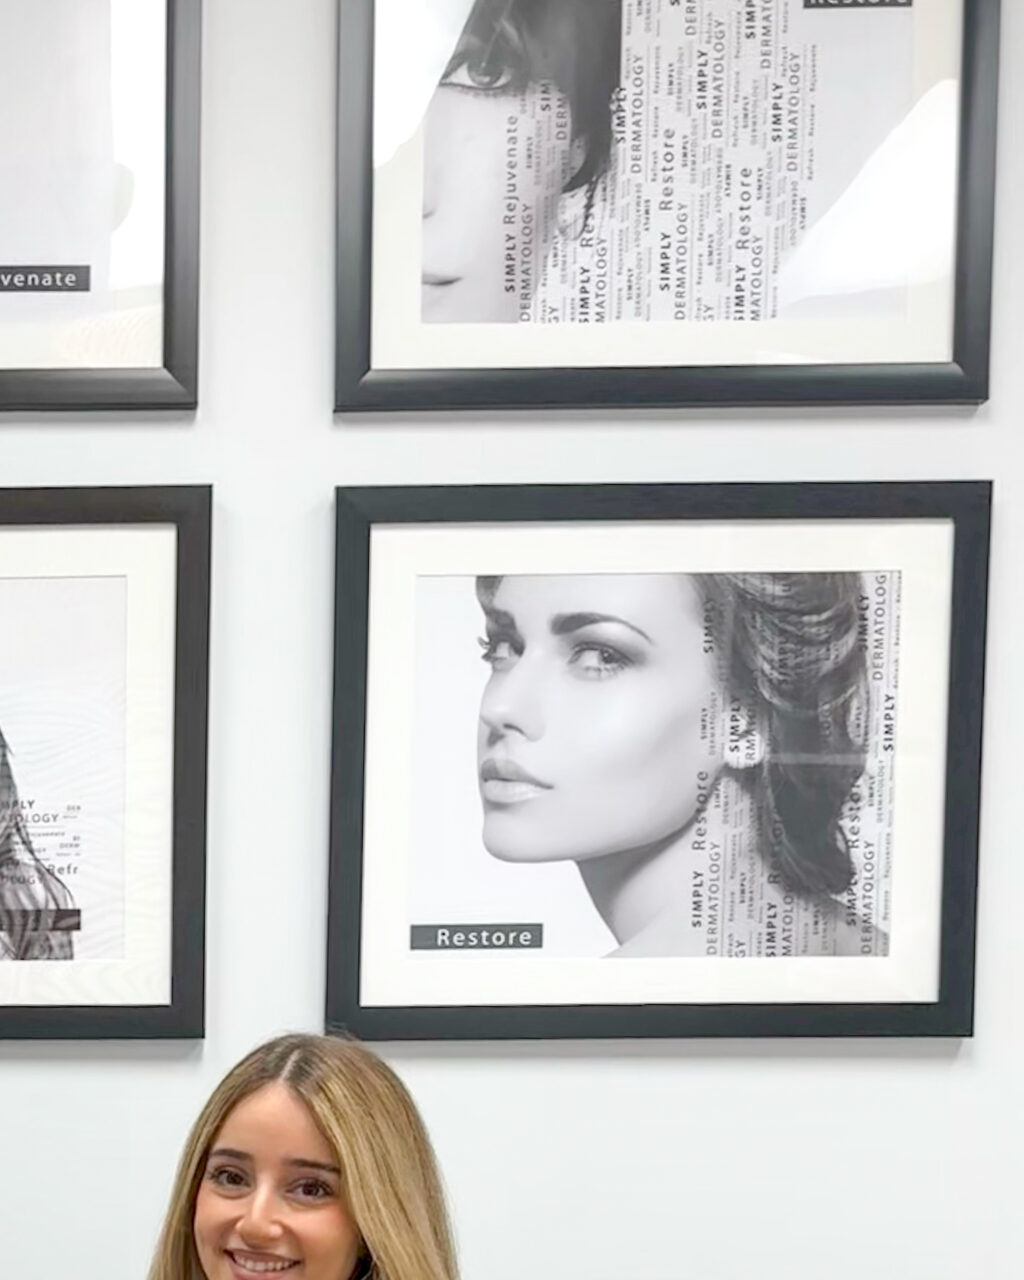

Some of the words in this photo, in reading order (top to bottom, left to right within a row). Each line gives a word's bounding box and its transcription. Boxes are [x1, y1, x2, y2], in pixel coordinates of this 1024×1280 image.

[615, 87, 627, 145] SIMPLY
[630, 55, 644, 174] DERMATOLOGY
[696, 49, 708, 110] SIMPLY
[711, 19, 726, 139] DERMATOLOGY
[771, 83, 783, 142] SIMPLY
[786, 52, 801, 172] DERMATOLOGY
[503, 115, 519, 224] Rejuvenate
[658, 127, 675, 211] Restore
[735, 167, 753, 250] Restore
[504, 233, 516, 293] SIMPLY
[519, 203, 533, 322] DERMATOLOGY
[578, 266, 590, 323] SIMPLY
[595, 237, 608, 323] MATOLOGY
[659, 232, 671, 292] SIMPLY
[674, 202, 689, 321] DERMATOLOGY
[733, 265, 746, 321] SIMPLY
[750, 235, 764, 321] MATOLOGY
[872, 574, 887, 681] DERMATOLOG
[882, 694, 895, 752] SIMPLY
[691, 770, 709, 851] Restore
[437, 928, 532, 946] Restore
[690, 870, 704, 928] SIMPLY
[706, 841, 721, 956] DERMATOLOGY
[765, 902, 777, 958] SIMPLY
[860, 840, 875, 955] DERMATOLOGY
